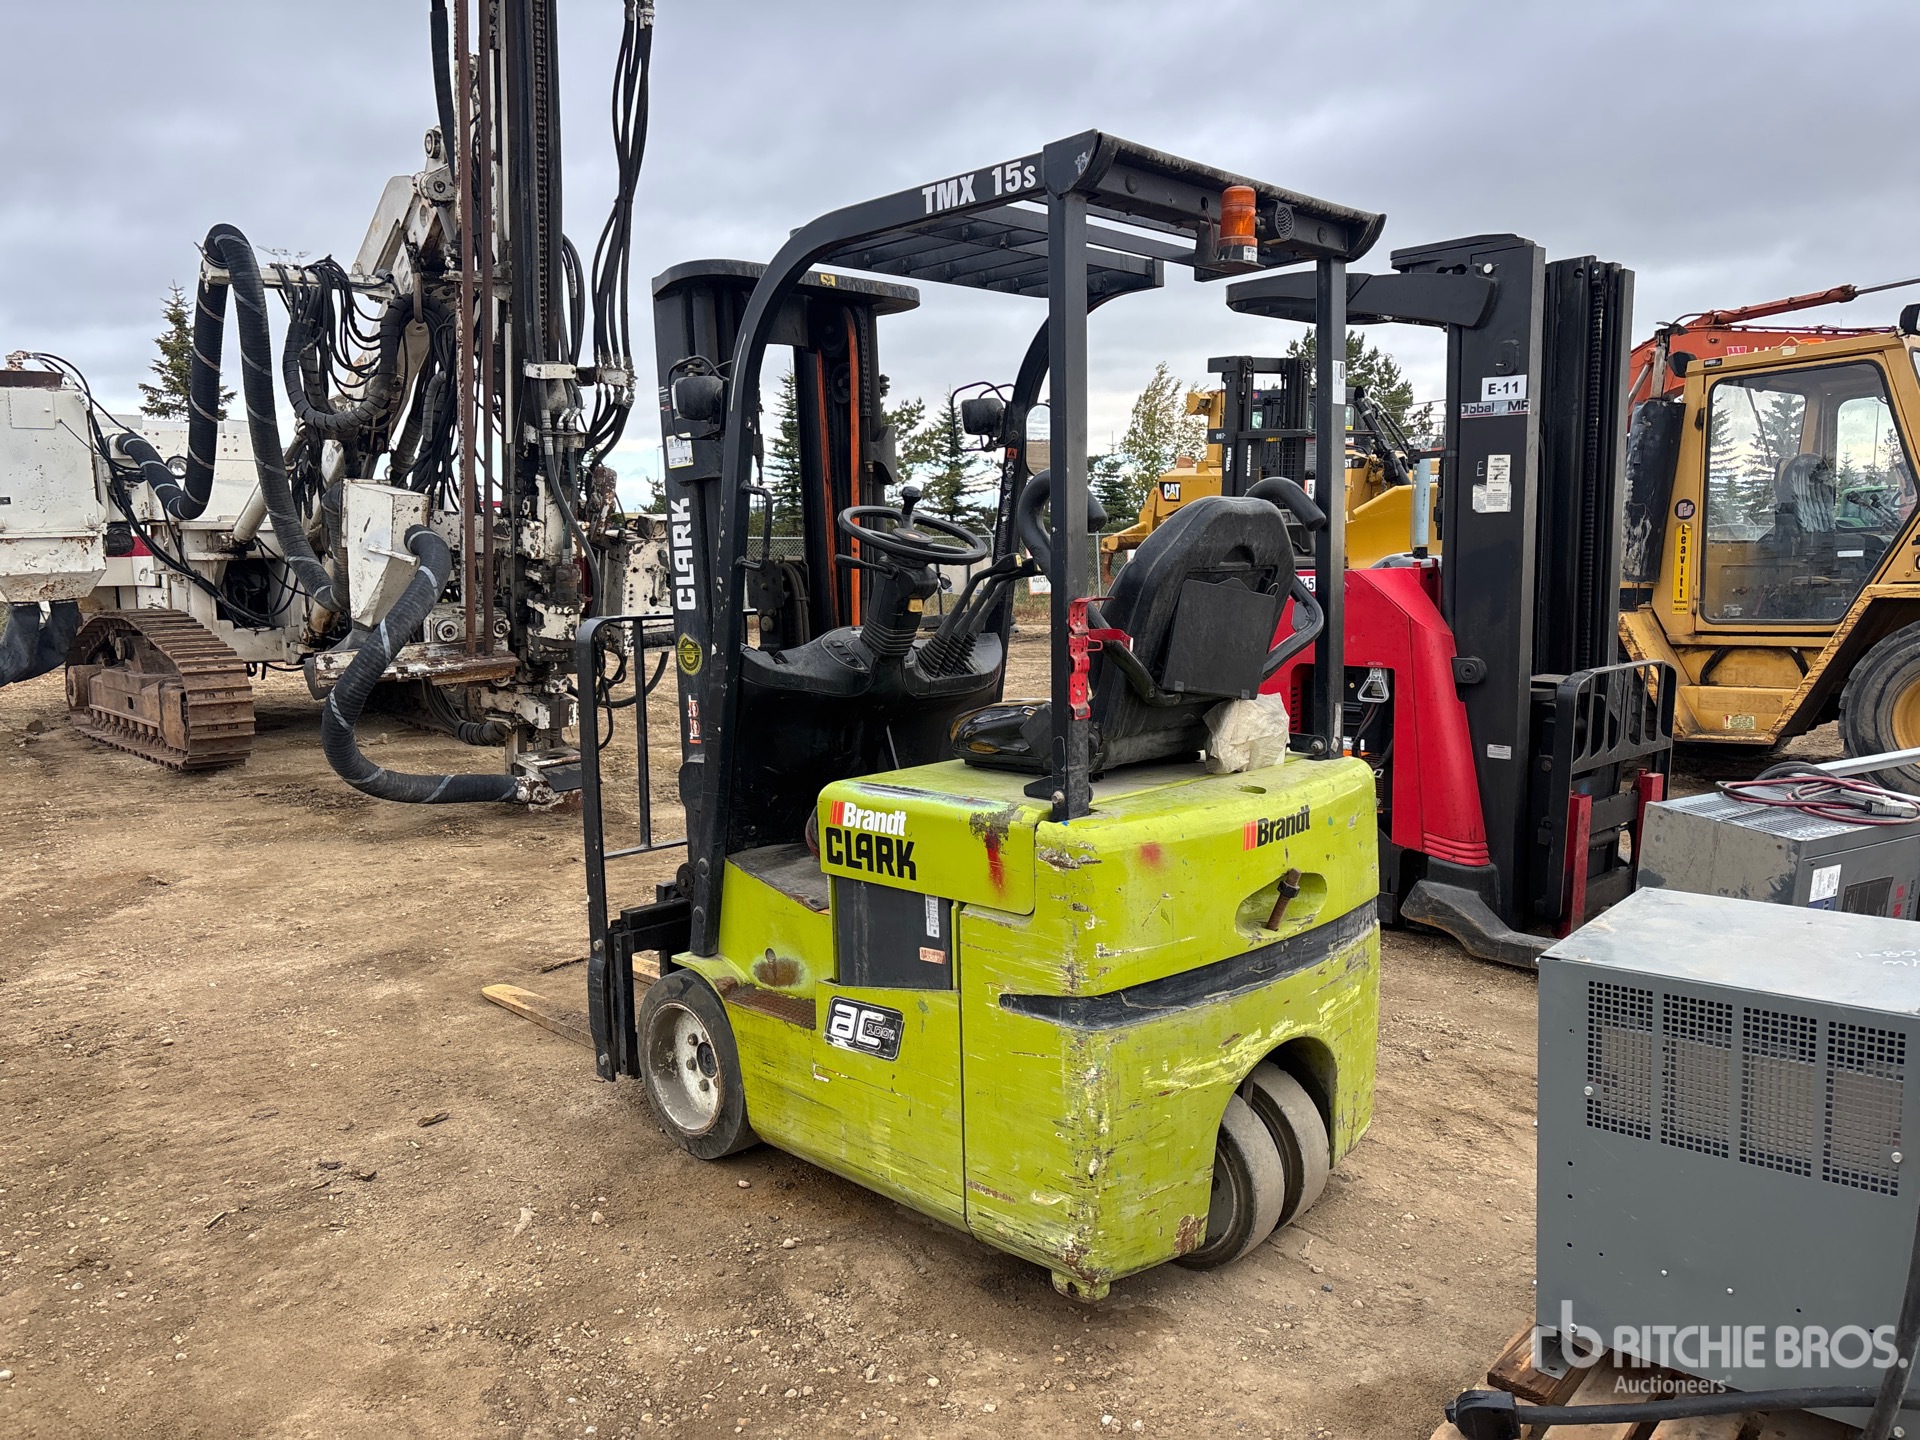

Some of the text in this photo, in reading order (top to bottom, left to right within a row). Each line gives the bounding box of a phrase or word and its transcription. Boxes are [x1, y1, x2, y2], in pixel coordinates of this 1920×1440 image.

[922, 161, 1036, 215] TMX 15s
[1488, 381, 1519, 395] E-11
[1164, 483, 1181, 500] CAT
[670, 497, 697, 611] CLARK
[1679, 525, 1687, 598] Leavitt
[843, 801, 907, 837] Brandt
[1257, 804, 1311, 848] Brandt
[826, 827, 917, 881] CLARK
